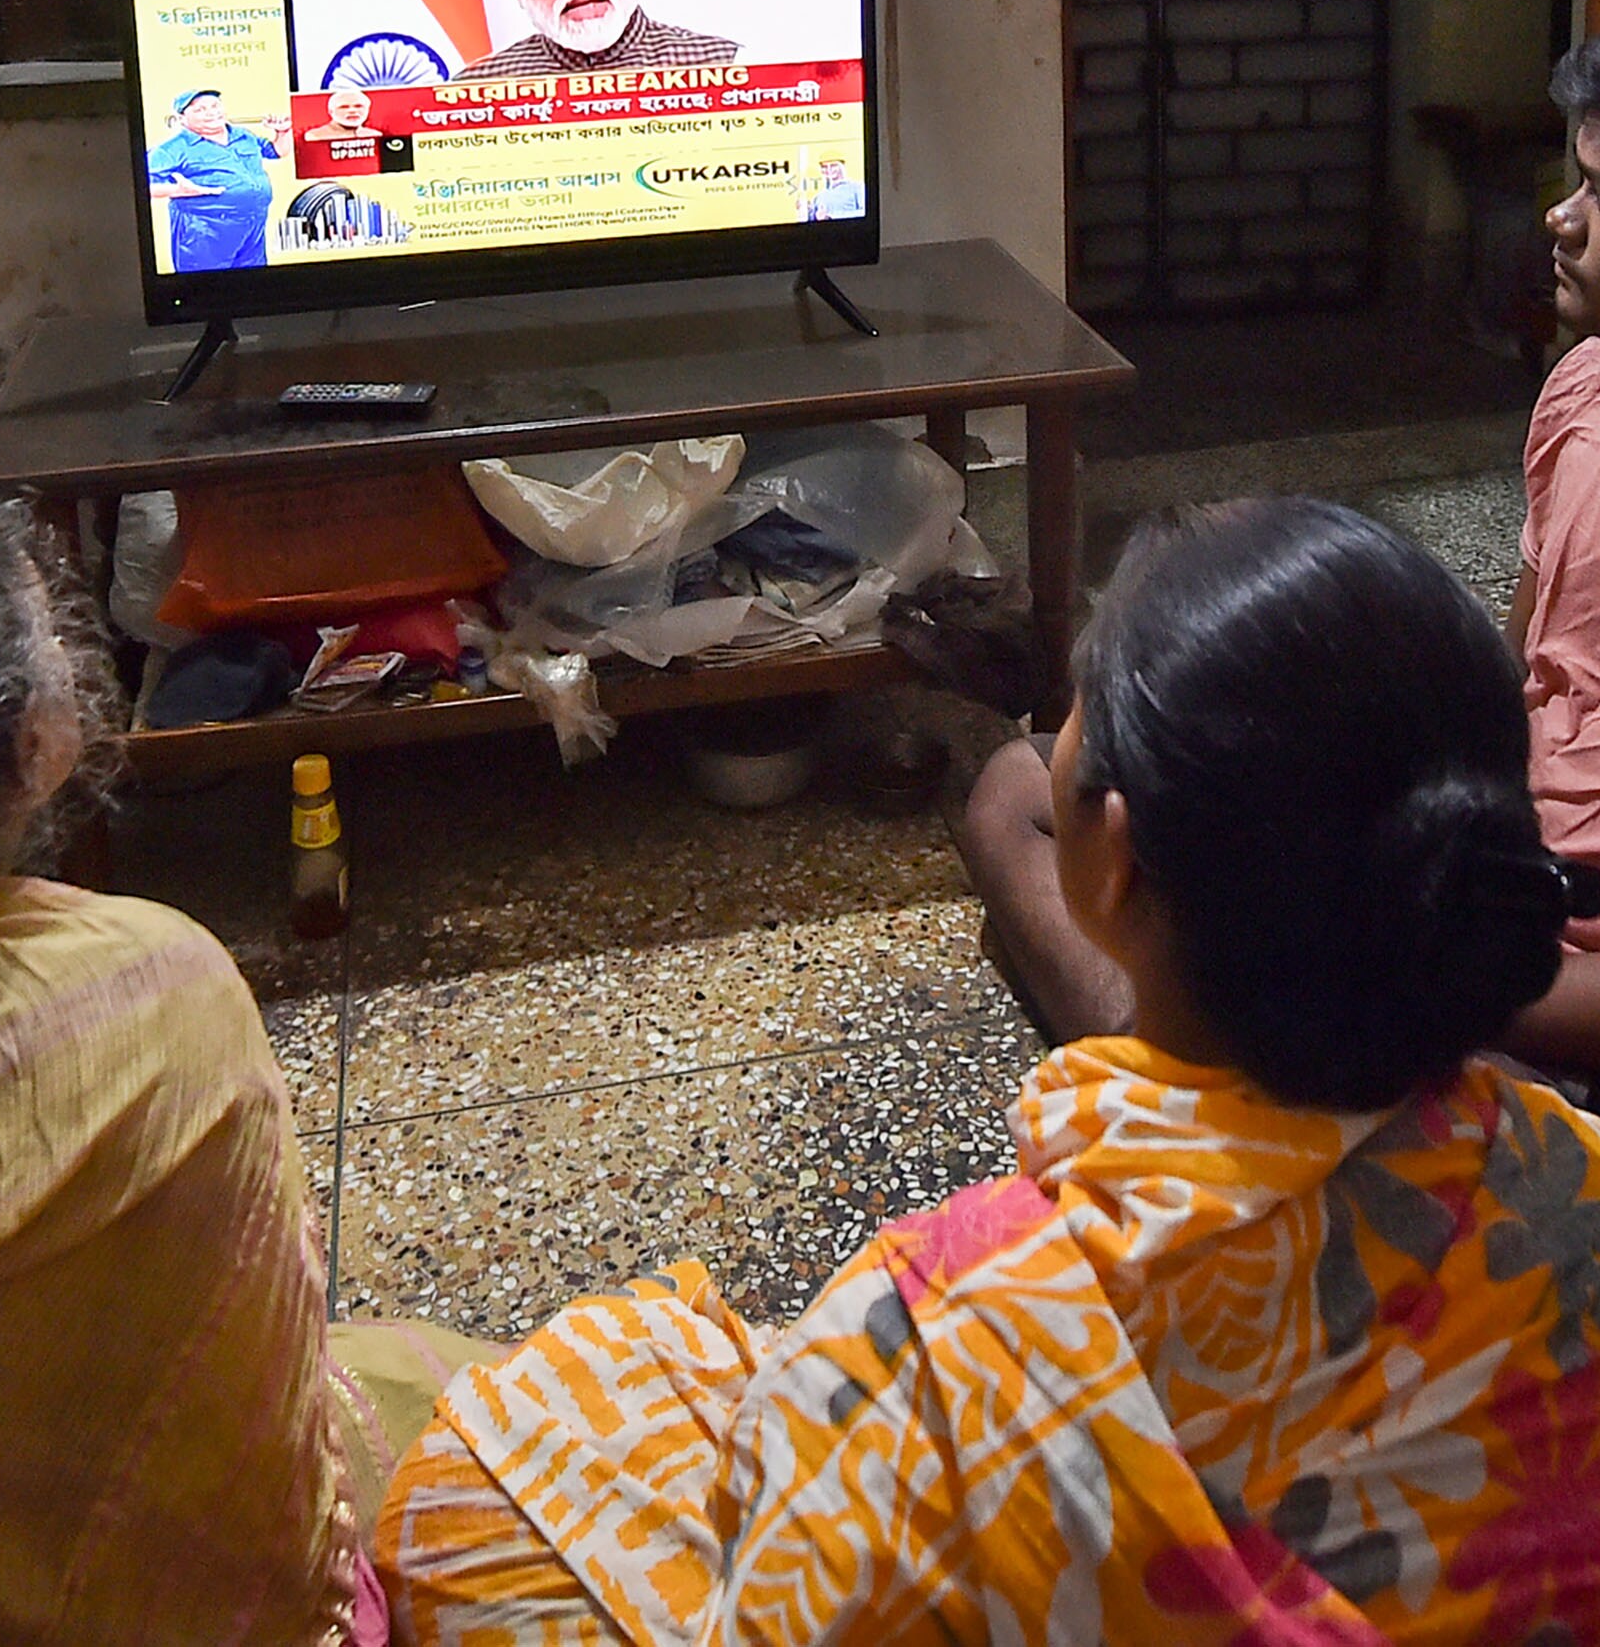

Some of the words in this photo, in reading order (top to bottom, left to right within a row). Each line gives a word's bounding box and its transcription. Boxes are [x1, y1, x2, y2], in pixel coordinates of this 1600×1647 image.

[432, 78, 558, 104] করোনা
[568, 66, 749, 96] BREAKING
[569, 97, 632, 116] সফল
[720, 79, 821, 106] প্রধানমন্ত্রী
[385, 138, 405, 152] ৩
[417, 132, 498, 150] লকডাউন
[577, 125, 622, 140] করার
[754, 116, 765, 127] ১
[331, 147, 375, 160] UPDATE
[652, 160, 790, 185] UTKARSH
